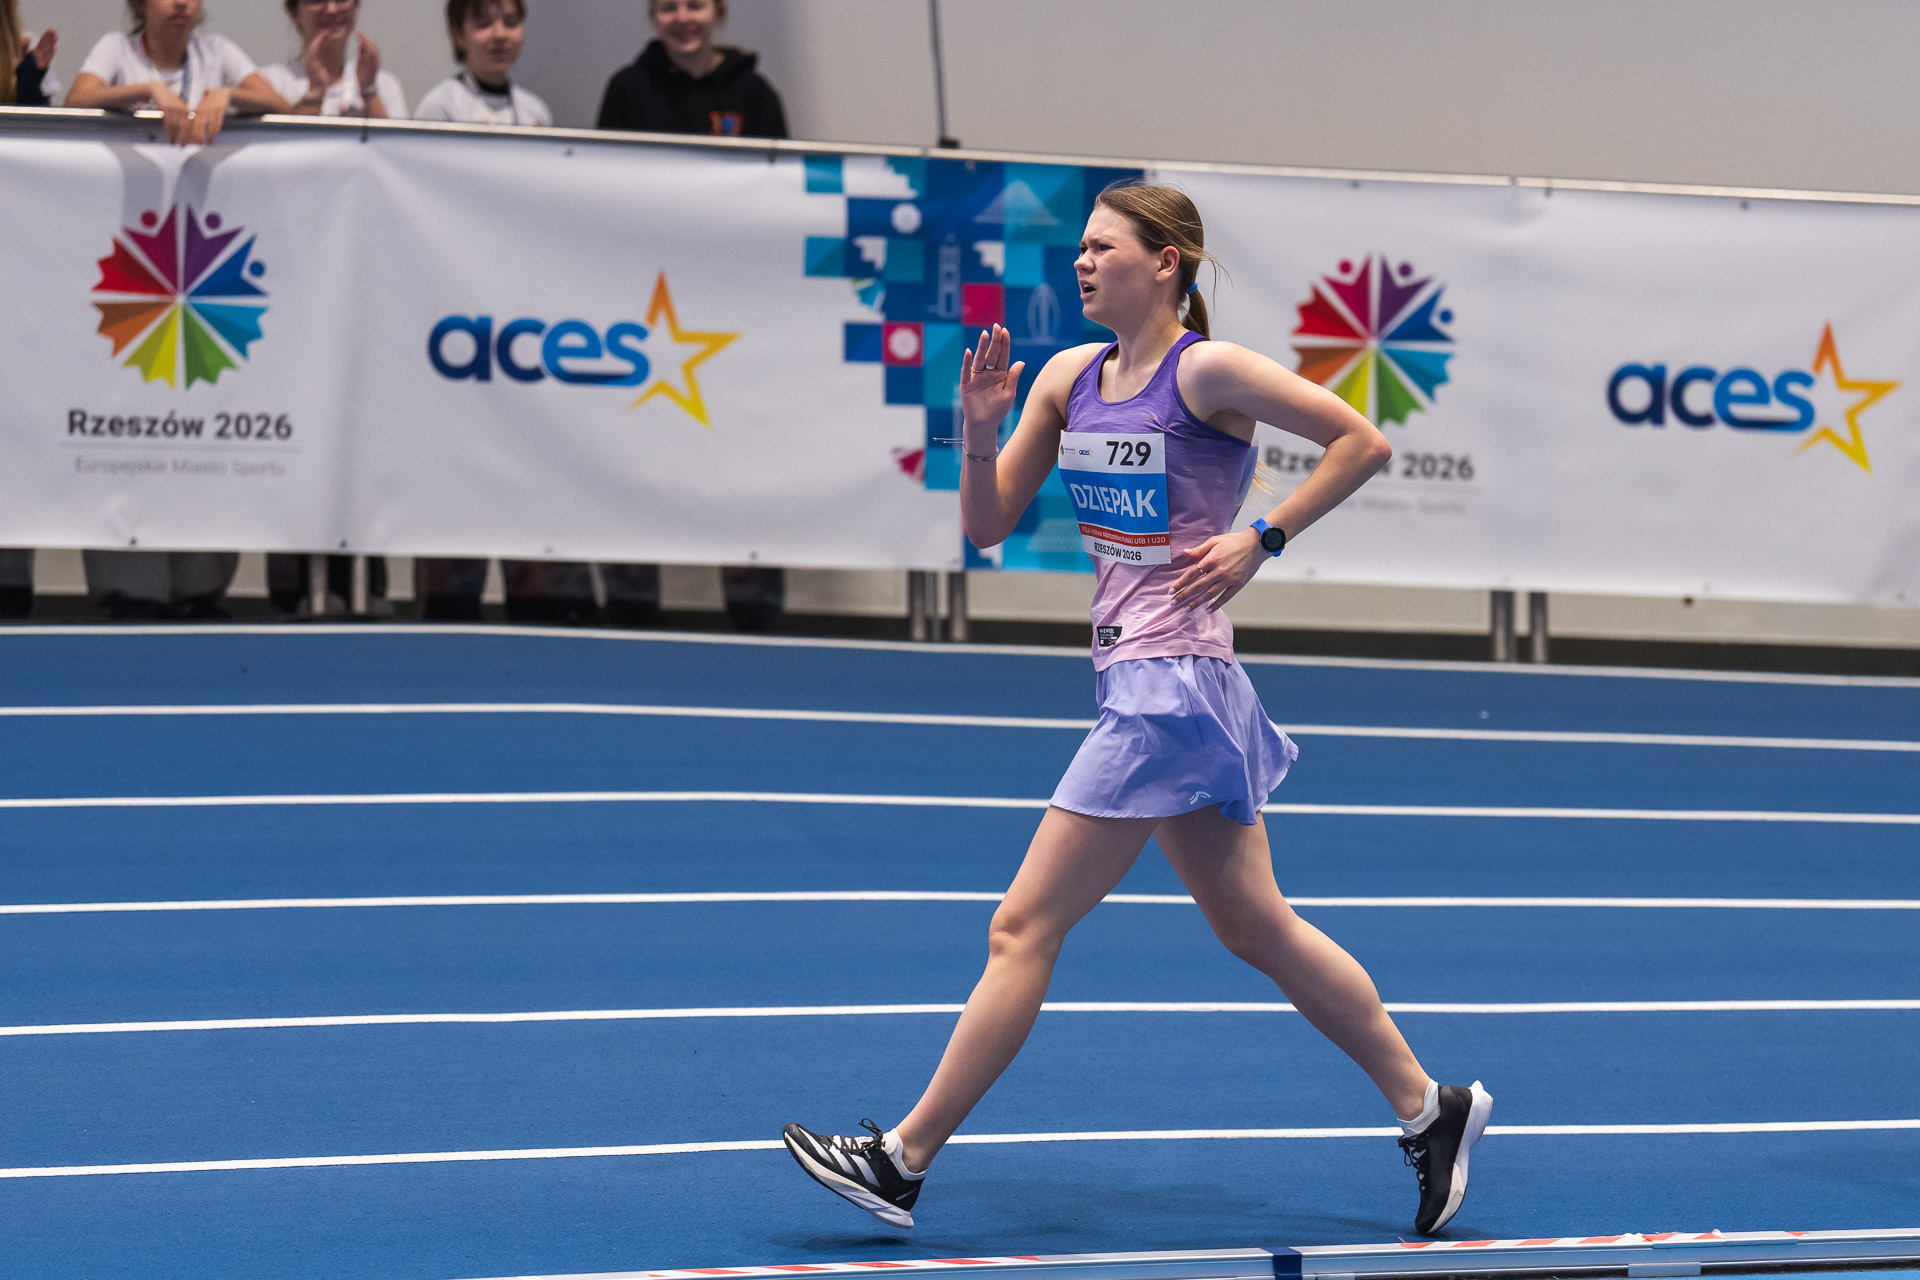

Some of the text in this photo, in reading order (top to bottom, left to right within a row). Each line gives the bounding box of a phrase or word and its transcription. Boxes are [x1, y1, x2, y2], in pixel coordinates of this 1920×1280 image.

[428, 315, 650, 387] aces
[1607, 363, 1816, 434] aces
[67, 408, 294, 440] Rzeszów 2026
[1106, 441, 1151, 466] 729
[1403, 452, 1474, 481] 2026
[1069, 483, 1158, 517] DZIEPAK
[1094, 542, 1142, 561] RZESZÓW 2026
